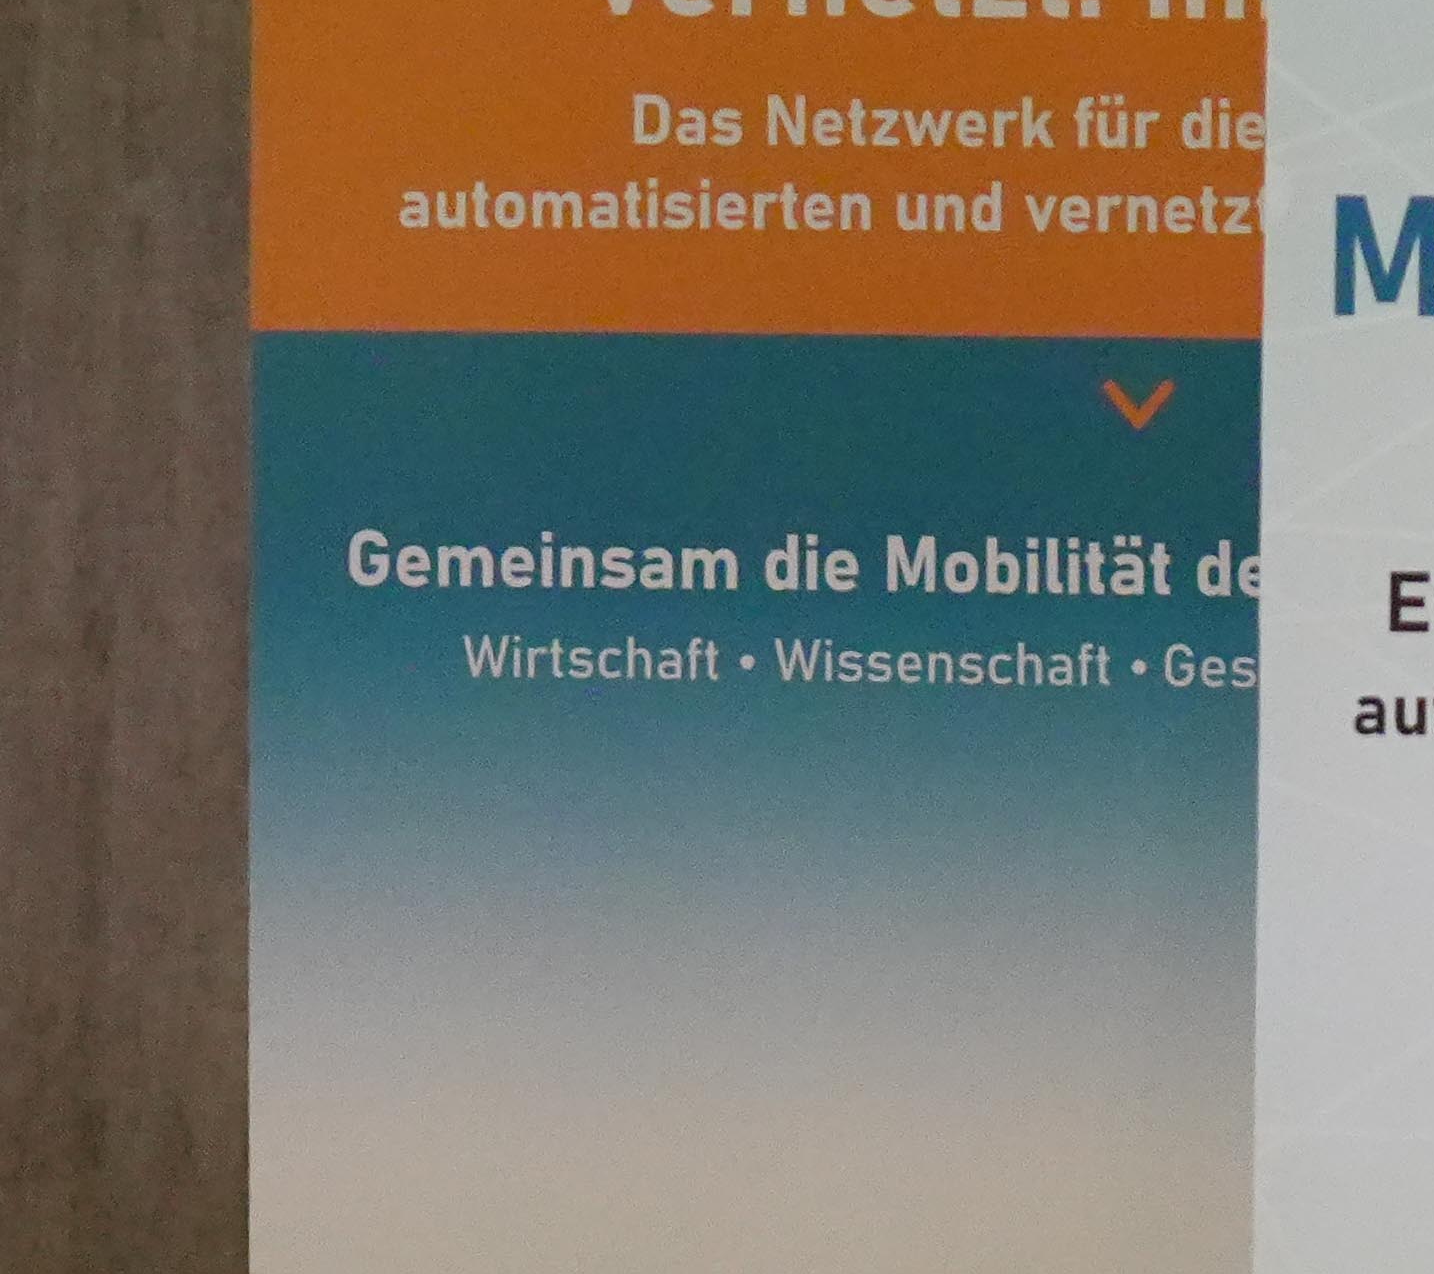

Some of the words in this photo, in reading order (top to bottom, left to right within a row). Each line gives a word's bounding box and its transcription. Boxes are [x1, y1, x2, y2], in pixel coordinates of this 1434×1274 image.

[633, 93, 743, 146] Das
[766, 94, 1053, 148] Netzwerk
[1074, 94, 1160, 148] für
[1181, 97, 1263, 151] die
[399, 178, 872, 230] automatisierten
[896, 181, 1003, 232] und
[348, 529, 739, 590] Gemeinsam
[764, 533, 859, 592] die
[886, 535, 1171, 596] Mobilität
[1197, 539, 1259, 599] de
[463, 635, 719, 681] Wirtschaft
[774, 638, 1111, 687] Wissenschaft
